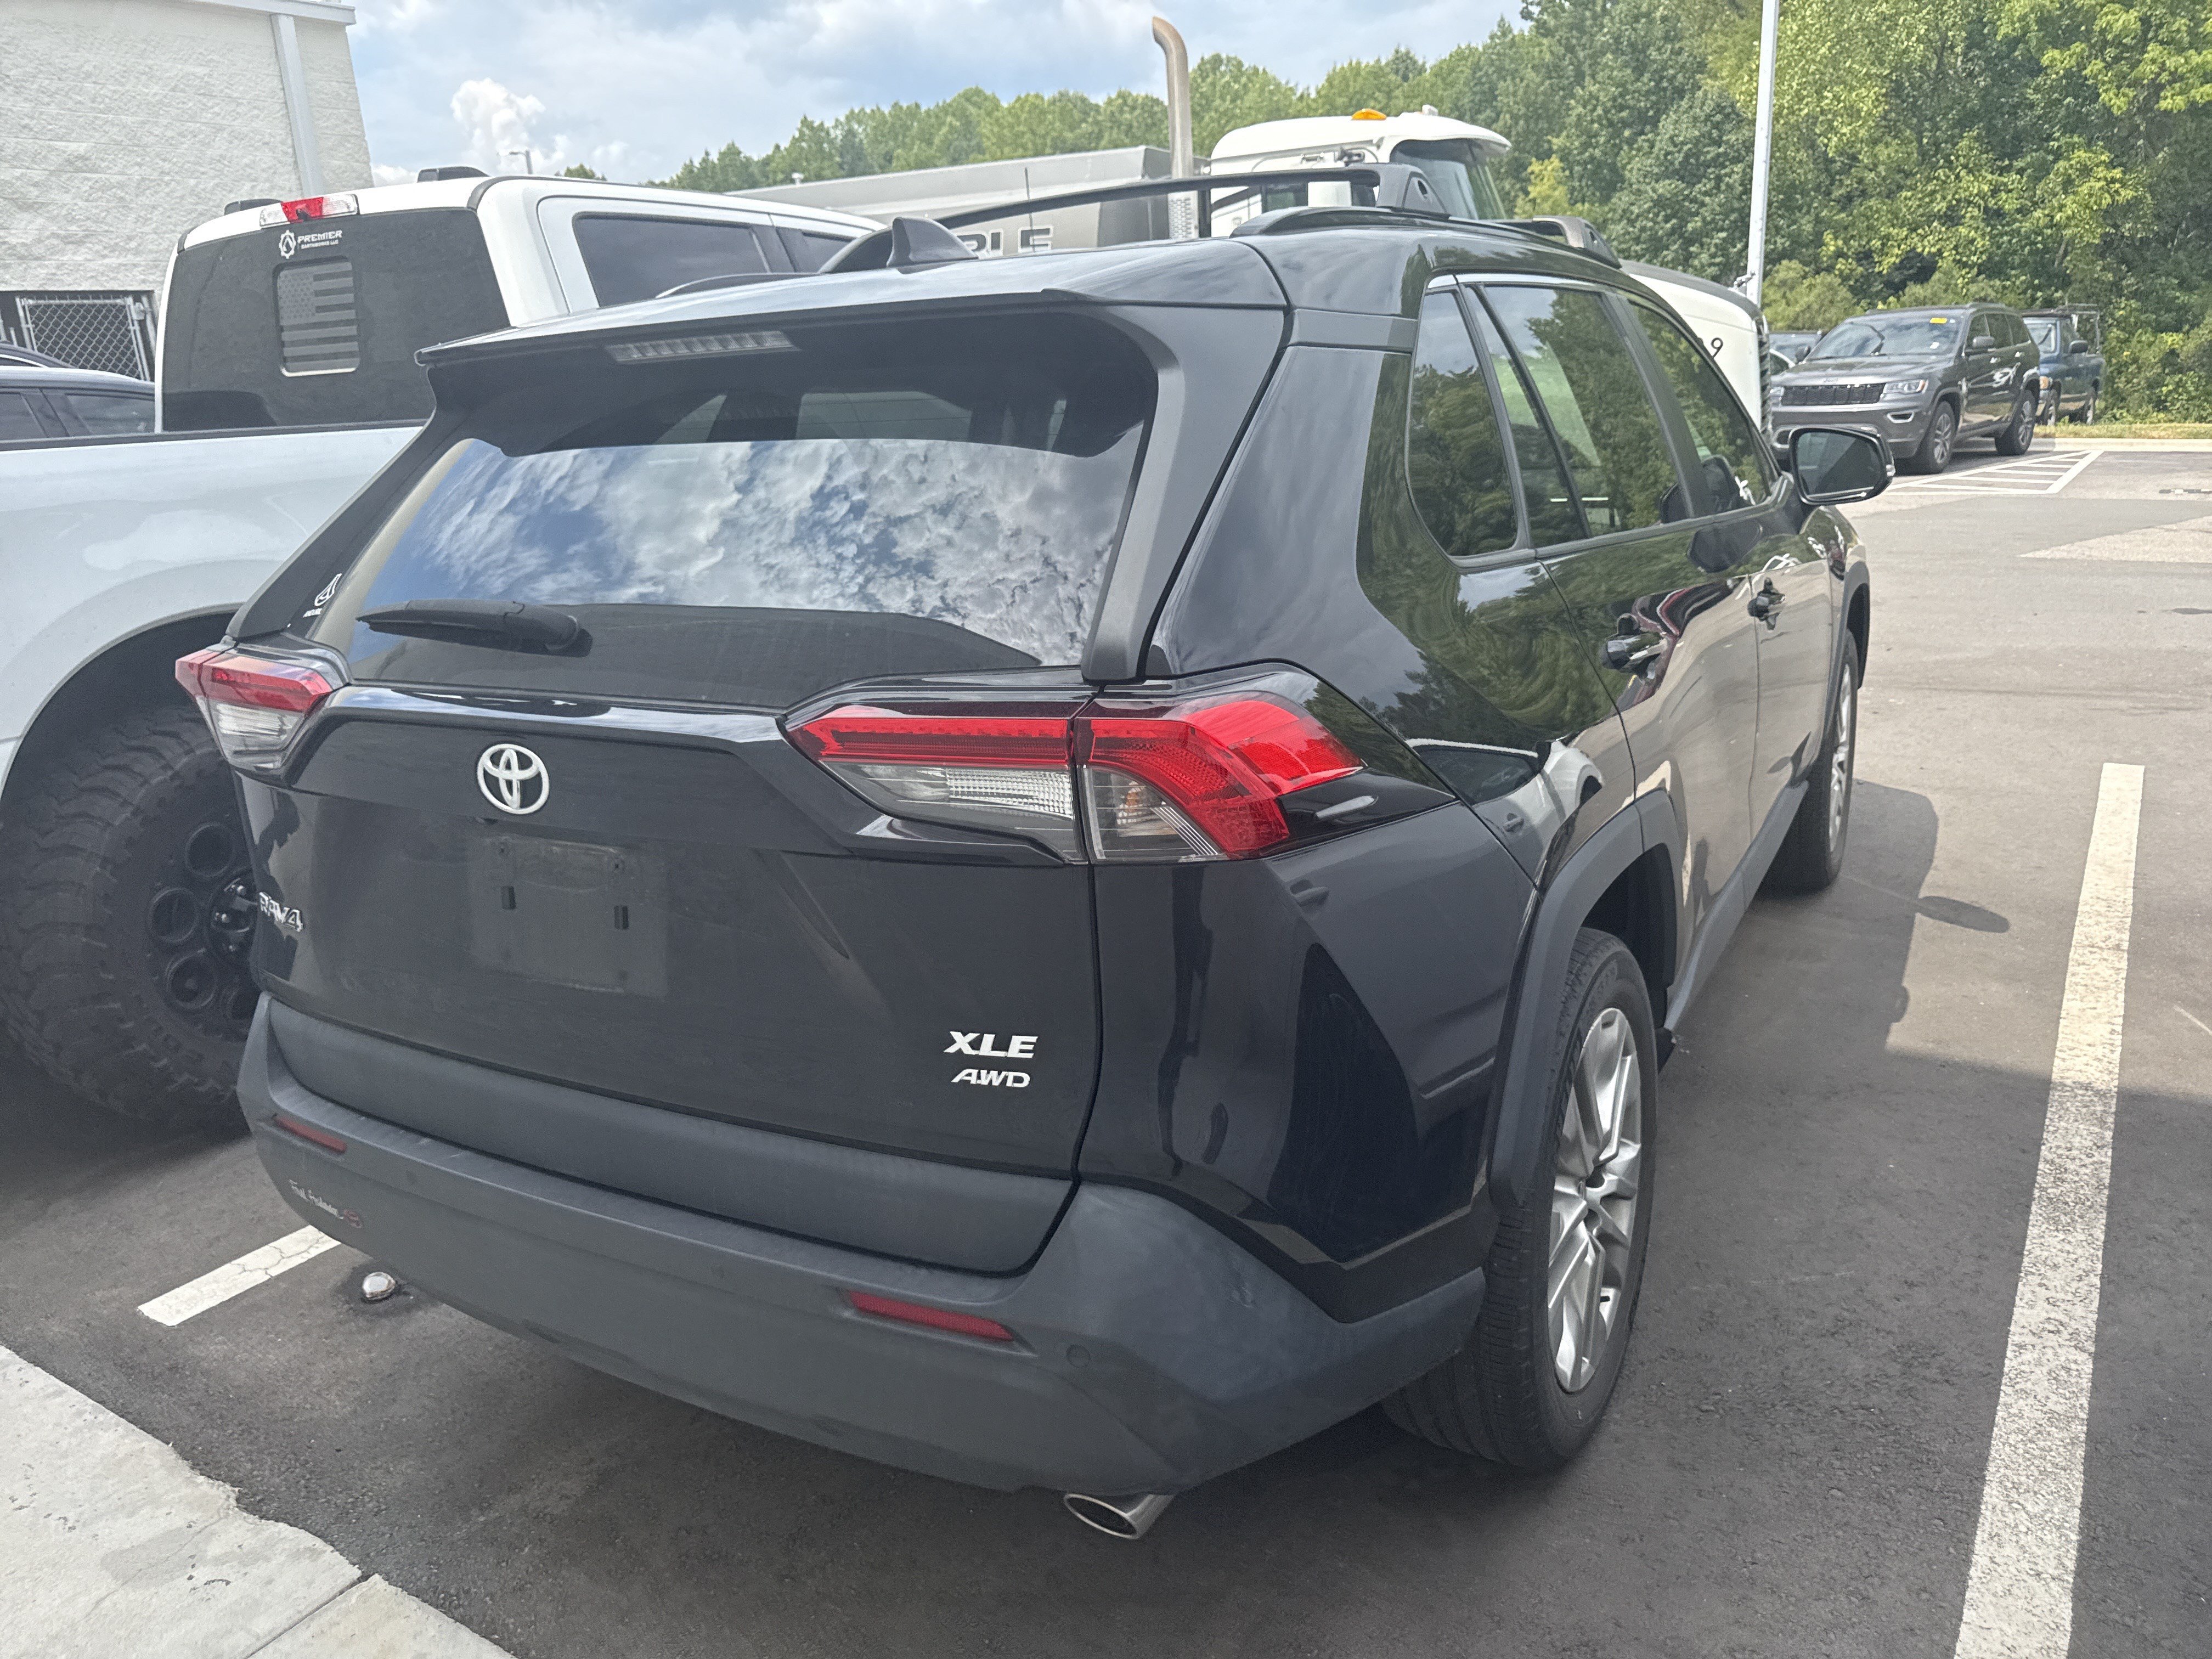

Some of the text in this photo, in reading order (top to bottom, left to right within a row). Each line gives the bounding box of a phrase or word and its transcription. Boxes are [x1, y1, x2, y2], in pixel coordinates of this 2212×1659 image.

[297, 230, 342, 243] PREMIER
[259, 892, 303, 932] RAV4
[944, 1031, 1038, 1058] XLE
[951, 1069, 1030, 1087] AWD
